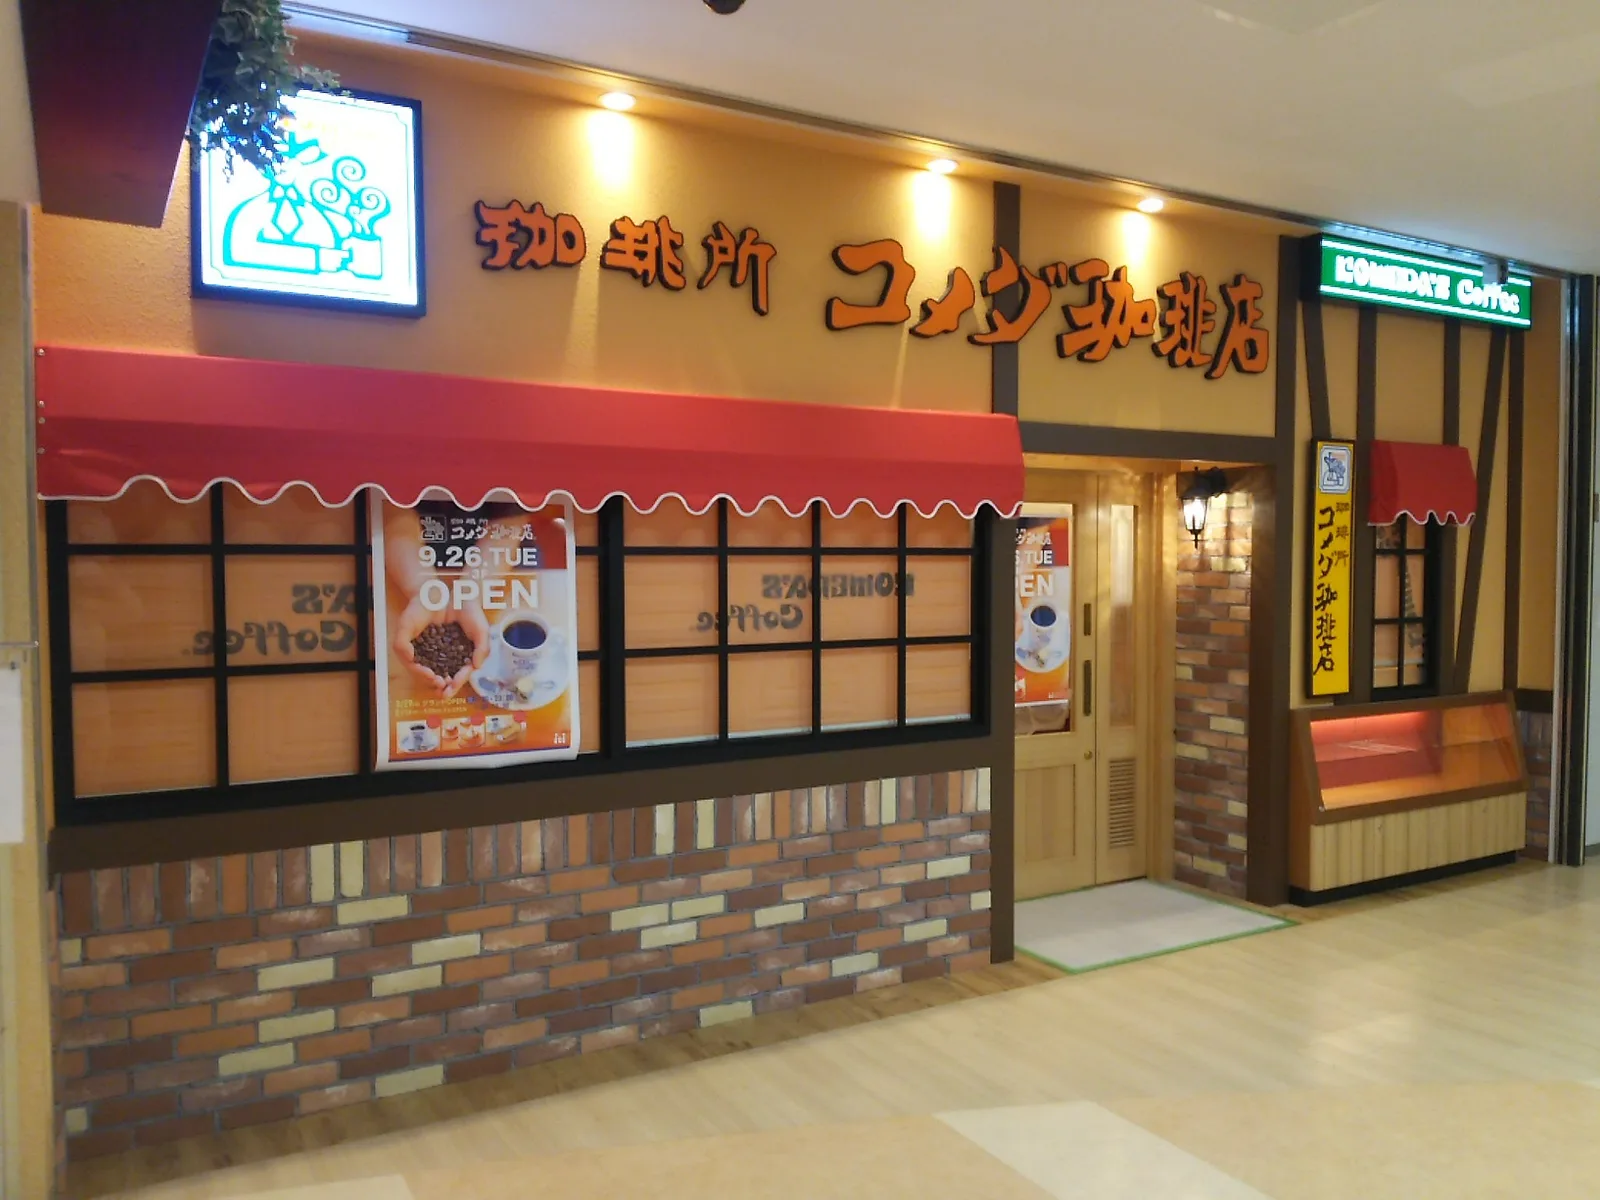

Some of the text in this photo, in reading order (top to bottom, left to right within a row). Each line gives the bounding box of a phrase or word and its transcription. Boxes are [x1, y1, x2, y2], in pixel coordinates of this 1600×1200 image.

[825, 238, 1271, 379] コメダ珈琲店
[1457, 279, 1520, 315] Coffee
[419, 579, 539, 612] OPEN
[1313, 505, 1338, 675] コメダ珈琲店
